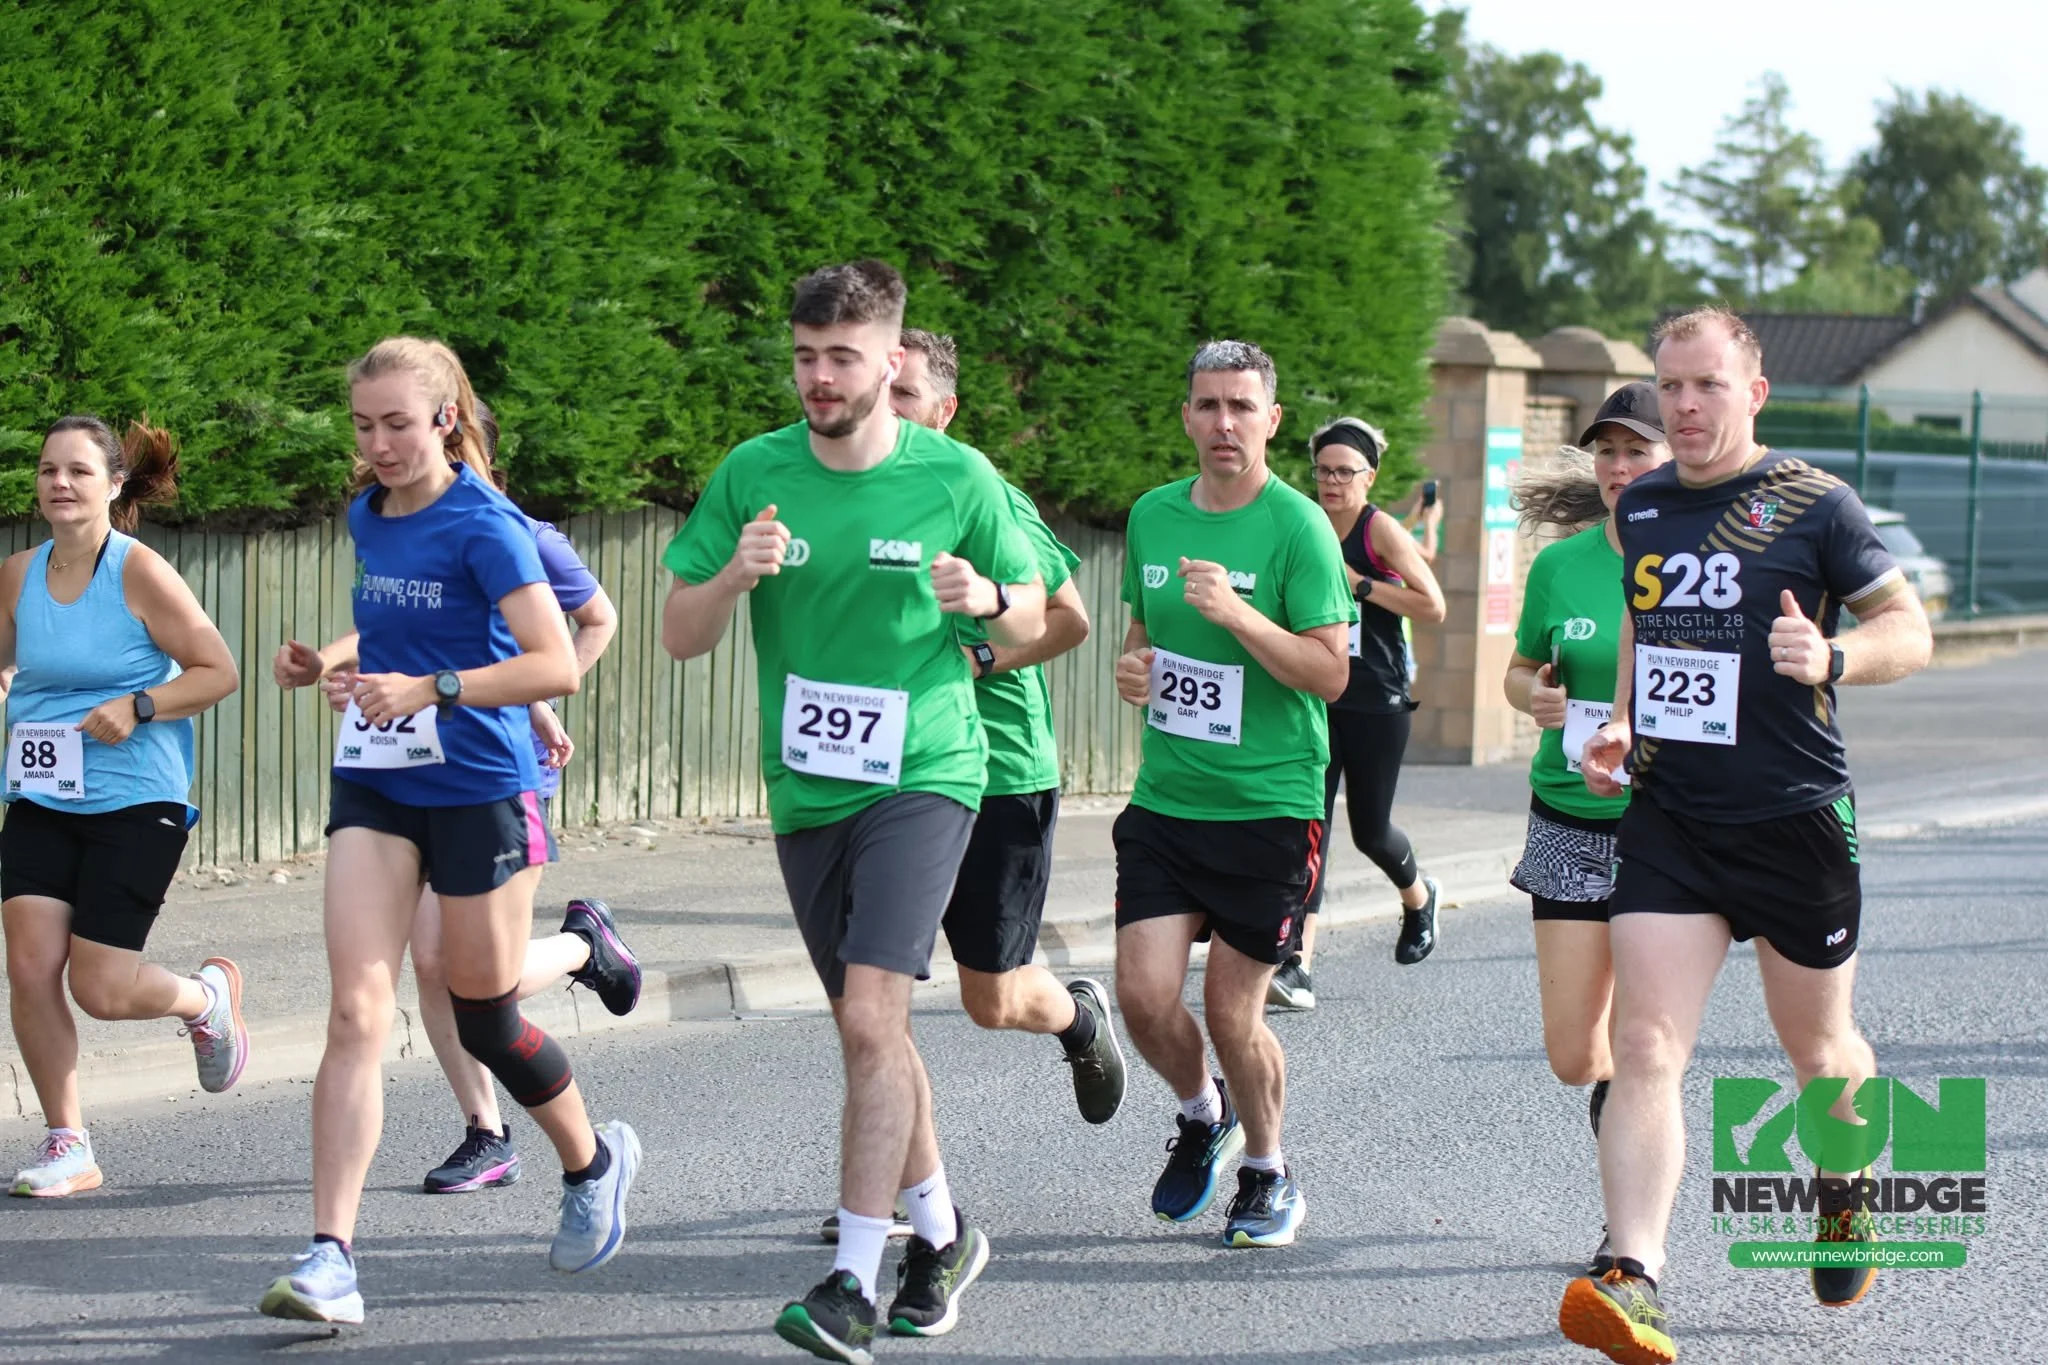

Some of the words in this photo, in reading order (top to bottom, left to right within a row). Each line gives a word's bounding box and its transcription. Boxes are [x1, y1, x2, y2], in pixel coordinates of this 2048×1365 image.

[362, 573, 406, 595] RUNNING
[406, 580, 443, 598] CLUB
[1632, 552, 1743, 611] S28
[361, 590, 442, 609] ANTRIM
[1634, 613, 1715, 628] STRENGTH
[1723, 613, 1744, 628] 28
[1662, 629, 1745, 640] EQUIPMENT
[1162, 657, 1177, 670] RUN
[1178, 662, 1224, 681] NEWBRIDGE
[1647, 653, 1663, 666] RUN
[1664, 656, 1720, 671] NEWBRIDGE
[1160, 671, 1222, 711] 293
[1647, 668, 1716, 707] 223
[801, 687, 820, 701] RUN
[822, 691, 886, 709] NEWBRIDGE
[1177, 707, 1199, 719] GARY
[1584, 707, 1604, 719] RUN
[1664, 706, 1693, 718] PHILIP
[798, 703, 882, 744] 297
[26, 729, 67, 738] NEWBRIDGE
[369, 735, 399, 746] ROISIN
[21, 740, 57, 769] 88
[818, 742, 856, 755] REMUS
[23, 771, 55, 780] AMANDA
